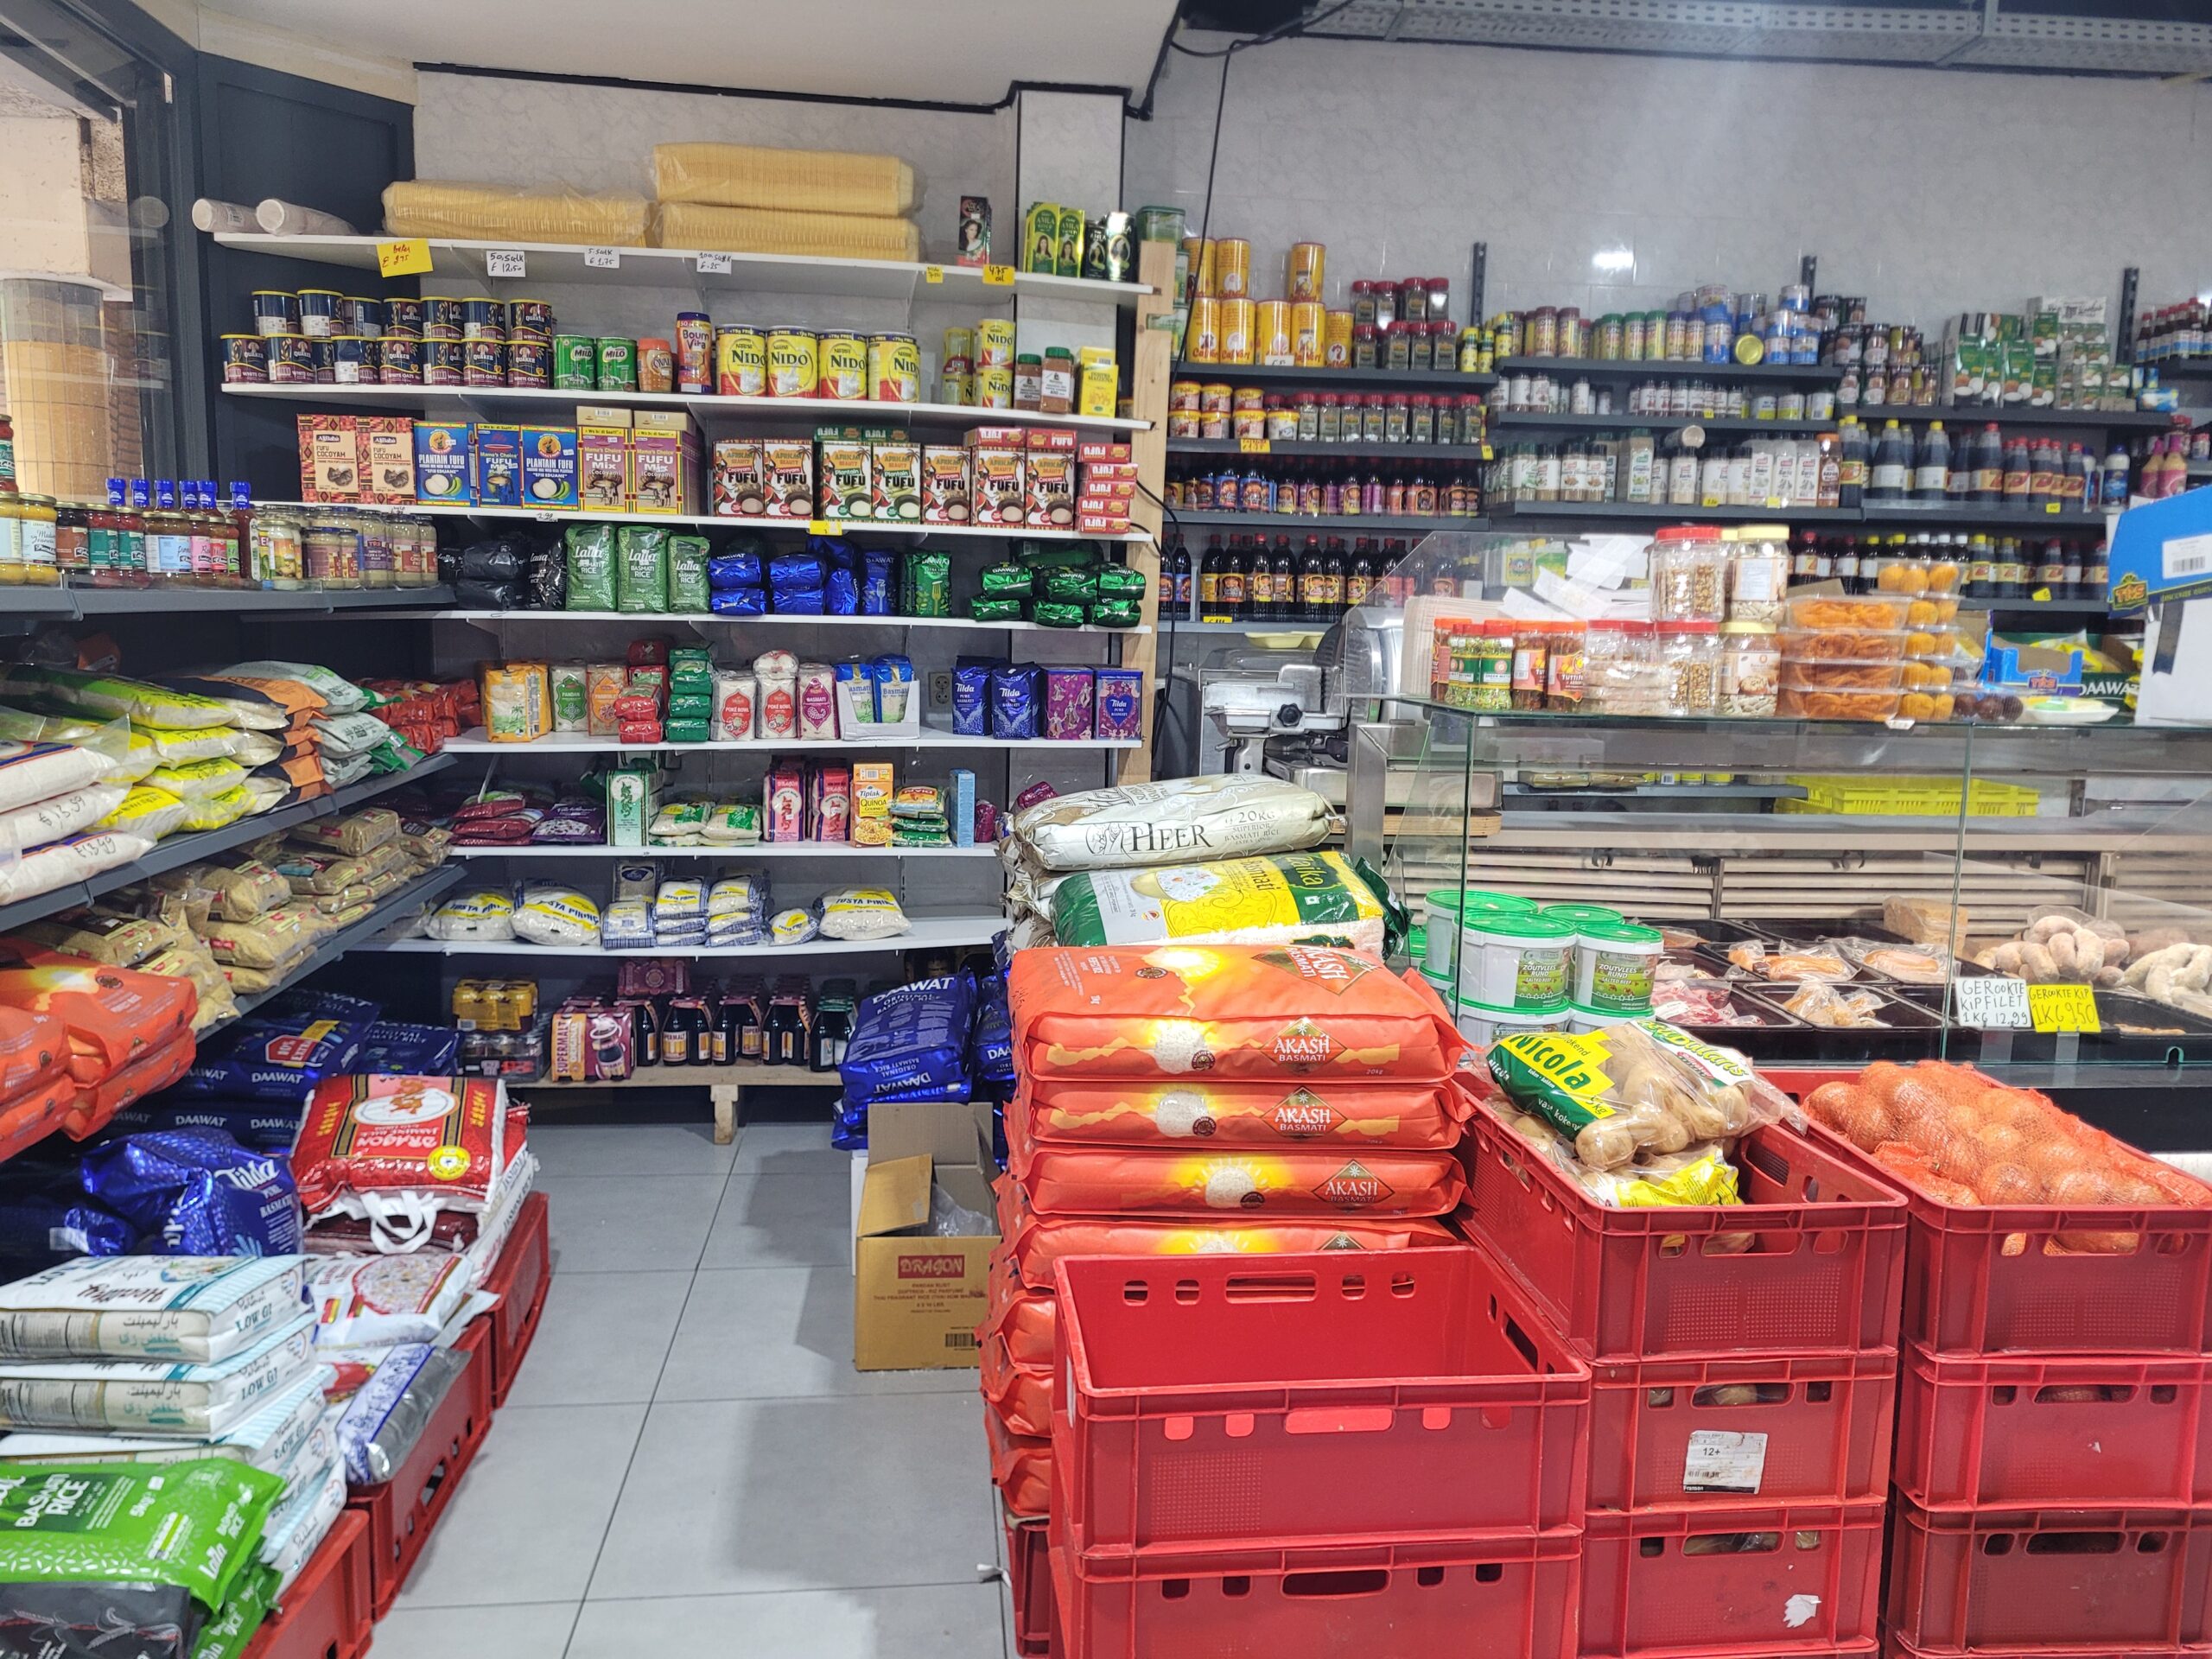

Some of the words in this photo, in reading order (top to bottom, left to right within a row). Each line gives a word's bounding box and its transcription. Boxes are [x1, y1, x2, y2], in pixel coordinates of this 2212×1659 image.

[987, 334, 1013, 345] NIDO
[575, 348, 593, 358] MILO
[605, 349, 625, 358] MILO
[732, 350, 766, 365] NIDO
[772, 352, 808, 365] NIDO
[830, 355, 865, 369] NIDO
[1051, 436, 1073, 446] FUFU
[419, 454, 448, 465] PLANTAIN
[449, 454, 465, 465] FUFU
[526, 459, 556, 468] PLANTAIN
[558, 459, 574, 468] FUFU
[586, 454, 621, 462] FUFU
[638, 455, 673, 464] FUFU
[728, 473, 758, 483] FUFU
[777, 473, 807, 484] FUFU
[836, 475, 865, 486] FUFU
[885, 477, 914, 487] FUFU
[937, 479, 965, 490] FUFU
[989, 481, 1019, 492] FUFU
[1039, 483, 1069, 493] FUFU
[955, 683, 975, 692] Tilda
[999, 687, 1020, 697] Tilda
[1110, 699, 1127, 708] Tilda
[861, 798, 887, 807] QUINOA
[1130, 823, 1215, 852] HEER
[1599, 963, 1637, 973] ZOUTVLEES
[1607, 970, 1628, 979] RUND
[873, 977, 955, 1005] DAAWAT
[1962, 981, 2024, 995] GEROOKTE
[2029, 988, 2071, 1001] GEROOKTE
[1974, 1013, 1987, 1022] KG
[1995, 1012, 2029, 1025] 12.99
[556, 1020, 568, 1073] SUPERMALT
[1274, 1034, 1330, 1055] AKASH
[1279, 1053, 1326, 1062] BASMATI
[1508, 1032, 1592, 1090] Nicola
[251, 1071, 304, 1084] DAAWAT
[874, 1071, 931, 1094] DAAWAT
[1274, 1106, 1332, 1124] AKASH
[175, 1114, 227, 1128] DAAWAT
[251, 1117, 302, 1130] DAAWA
[1280, 1123, 1327, 1132] BASMATI
[214, 1159, 279, 1190] Tilda
[1325, 1180, 1378, 1197] AKASH
[899, 1257, 963, 1273] DRAGON
[1703, 1447, 1720, 1456] 12+
[47, 1480, 90, 1515] RICE
